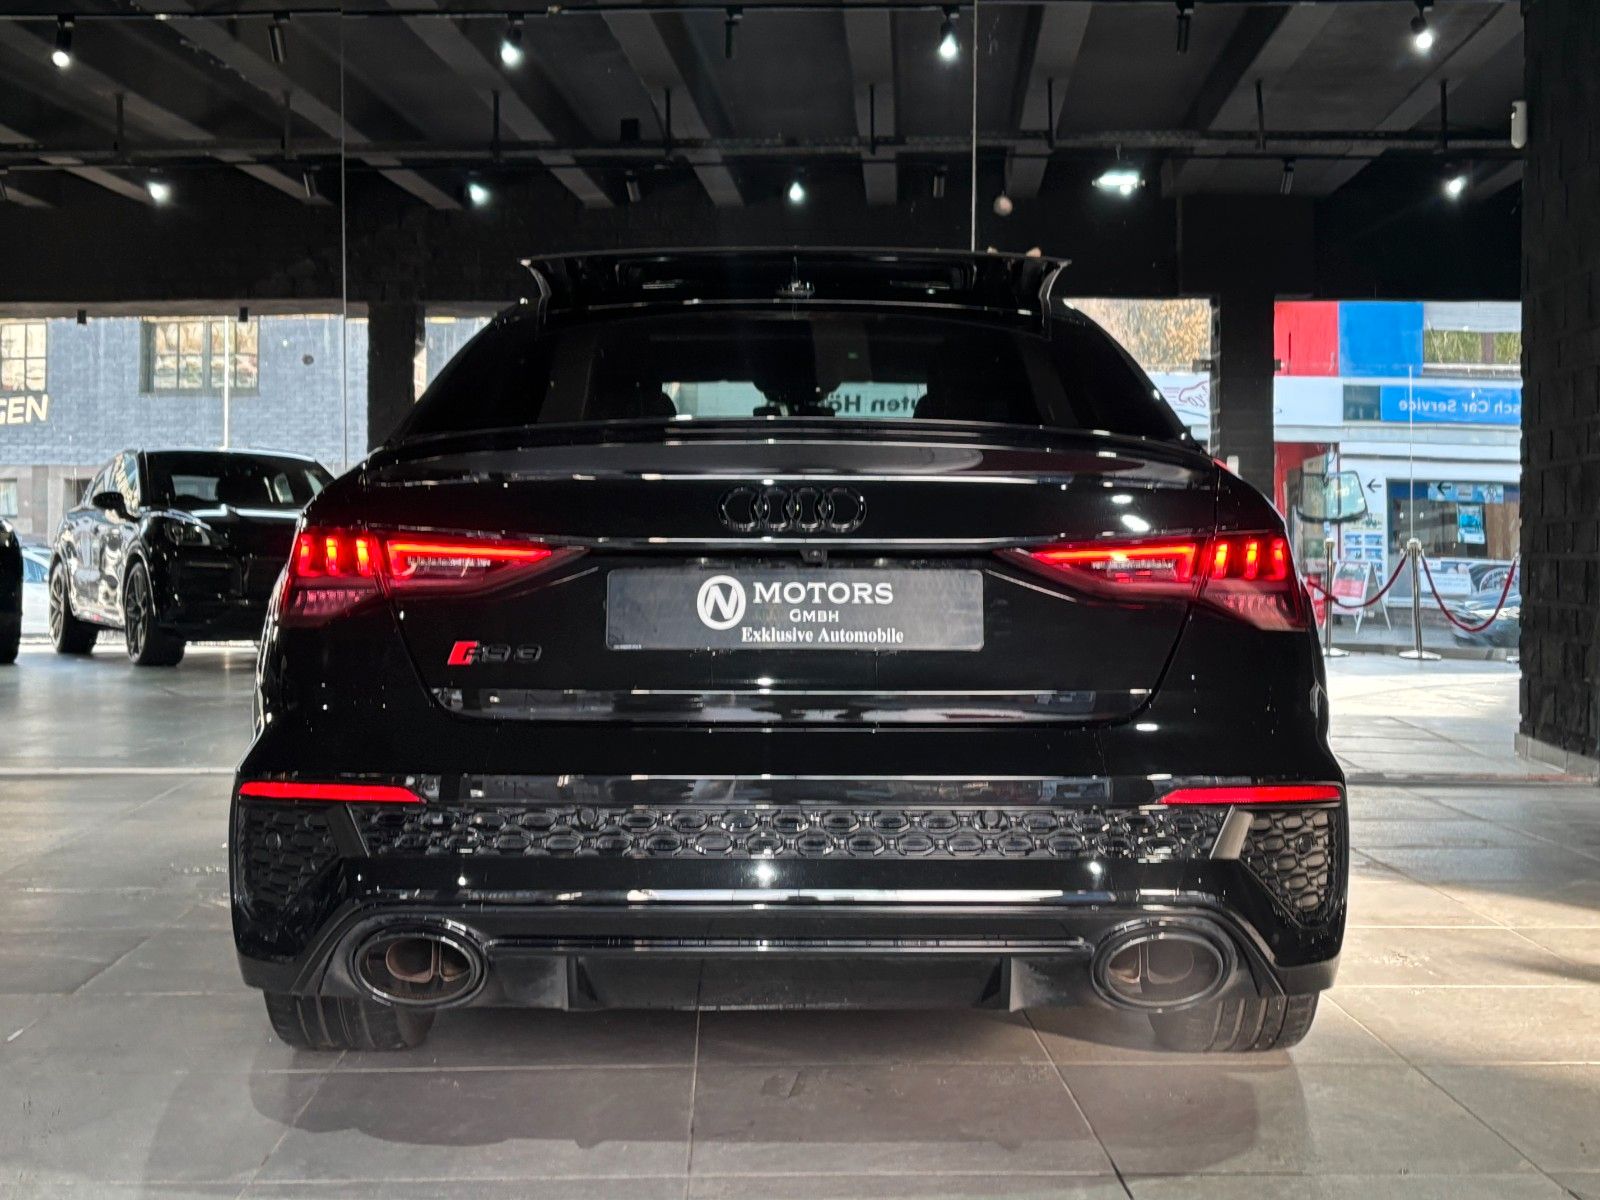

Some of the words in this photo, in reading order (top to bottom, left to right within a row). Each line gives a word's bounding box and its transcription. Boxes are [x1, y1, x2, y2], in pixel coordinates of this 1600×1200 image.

[753, 582, 894, 605] MOTORS
[789, 609, 840, 623] GMBH
[742, 627, 814, 643] Exklusive
[818, 627, 904, 643] Automobile
